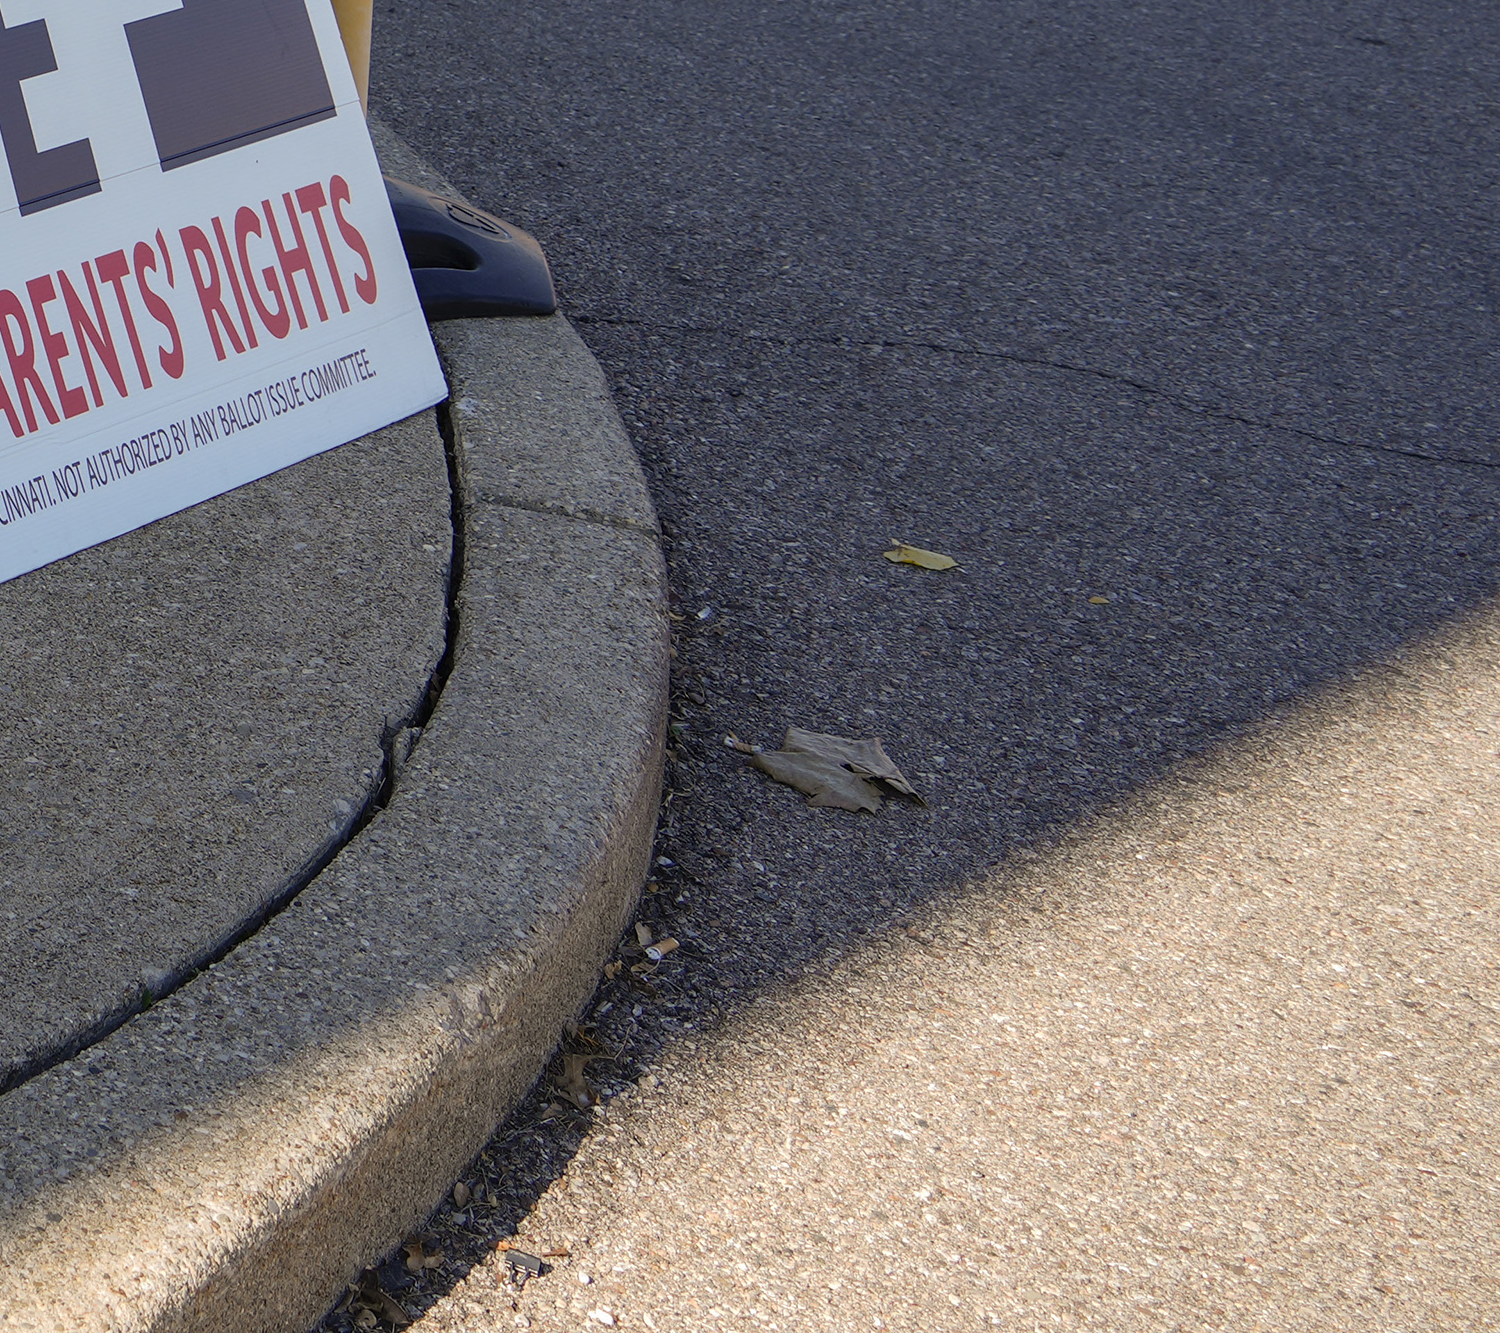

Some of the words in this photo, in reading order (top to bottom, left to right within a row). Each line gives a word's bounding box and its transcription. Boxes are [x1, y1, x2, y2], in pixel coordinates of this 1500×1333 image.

[190, 174, 380, 363] RIGHTS
[50, 461, 86, 503] NOT
[86, 428, 174, 491] AUTHORIZED
[169, 419, 192, 457] BY
[190, 408, 221, 449] ANY
[216, 389, 270, 437] BALLOT
[264, 376, 304, 417] ISSUE
[300, 348, 377, 404] COMMITTEE.
